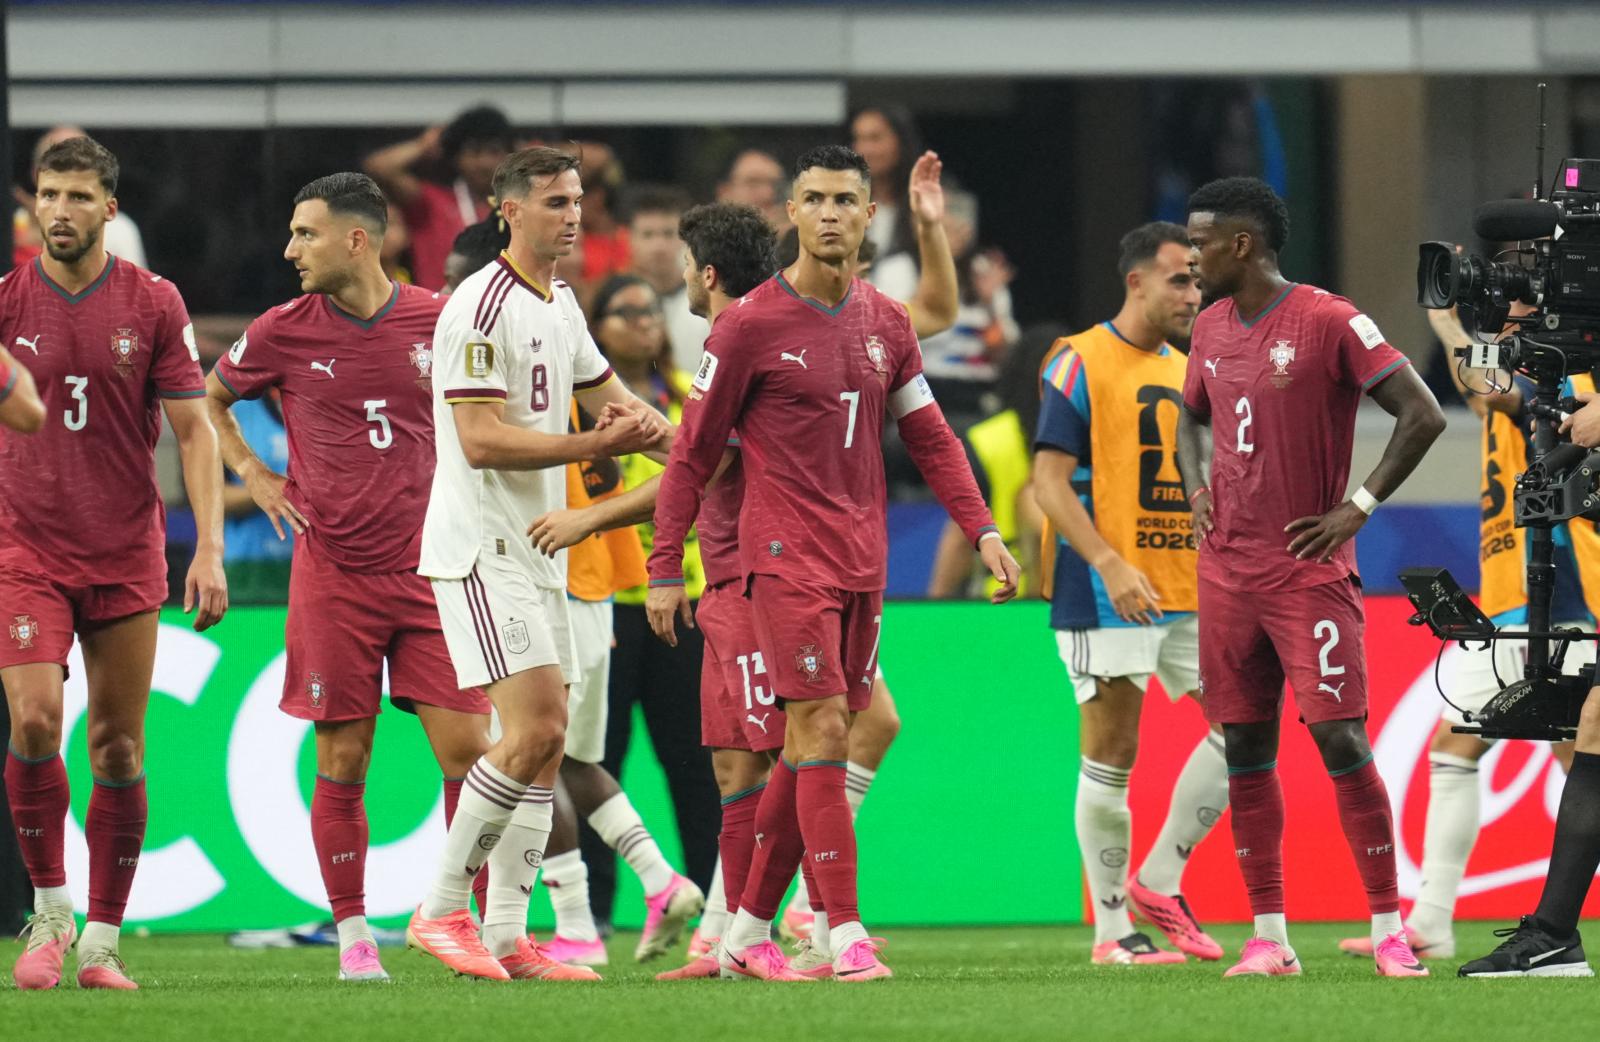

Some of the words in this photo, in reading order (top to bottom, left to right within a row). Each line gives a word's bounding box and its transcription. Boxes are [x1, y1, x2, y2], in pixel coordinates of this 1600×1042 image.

[63, 375, 88, 431] 3
[531, 364, 549, 412] 8
[363, 399, 393, 449] 5
[840, 391, 860, 449] 7
[1235, 396, 1254, 452] 2
[1152, 486, 1185, 502] FIFA
[1313, 619, 1346, 677] 2
[1499, 685, 1533, 714] STEADICAM
